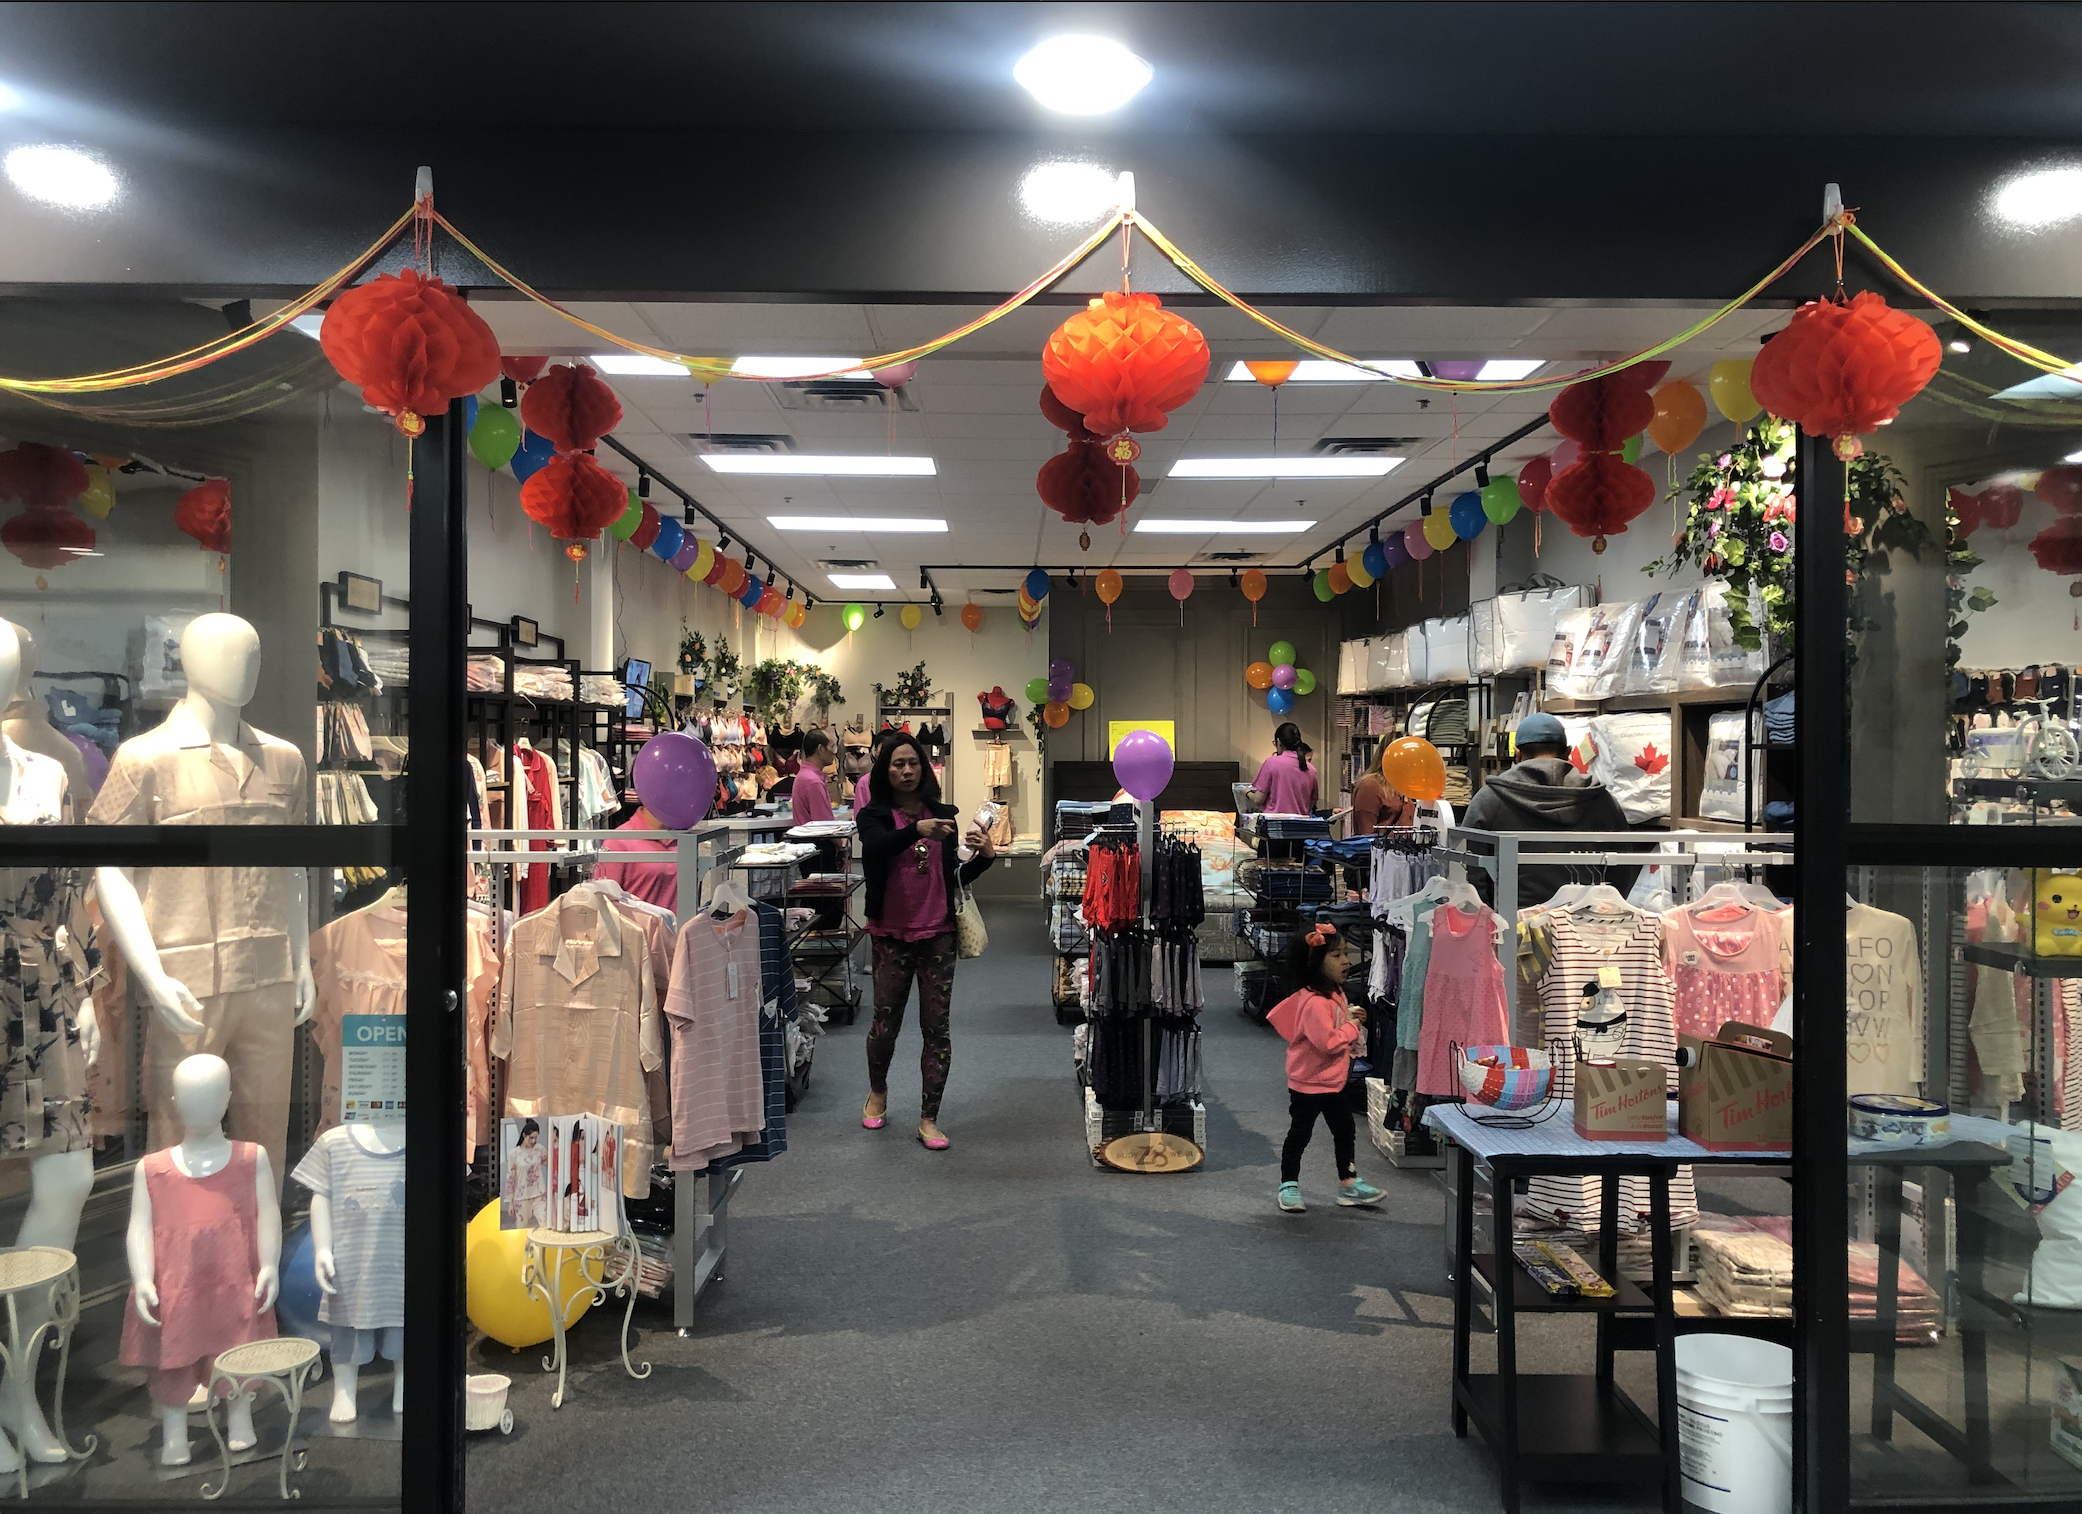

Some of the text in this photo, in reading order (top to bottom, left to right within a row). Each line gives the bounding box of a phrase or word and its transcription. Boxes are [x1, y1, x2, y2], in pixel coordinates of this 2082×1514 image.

[1115, 440, 1132, 460] 福
[357, 1026, 407, 1042] OPEN
[1590, 1101, 1616, 1120] Tim
[1617, 1085, 1663, 1111] Hortons
[1716, 1100, 1754, 1130] Tim
